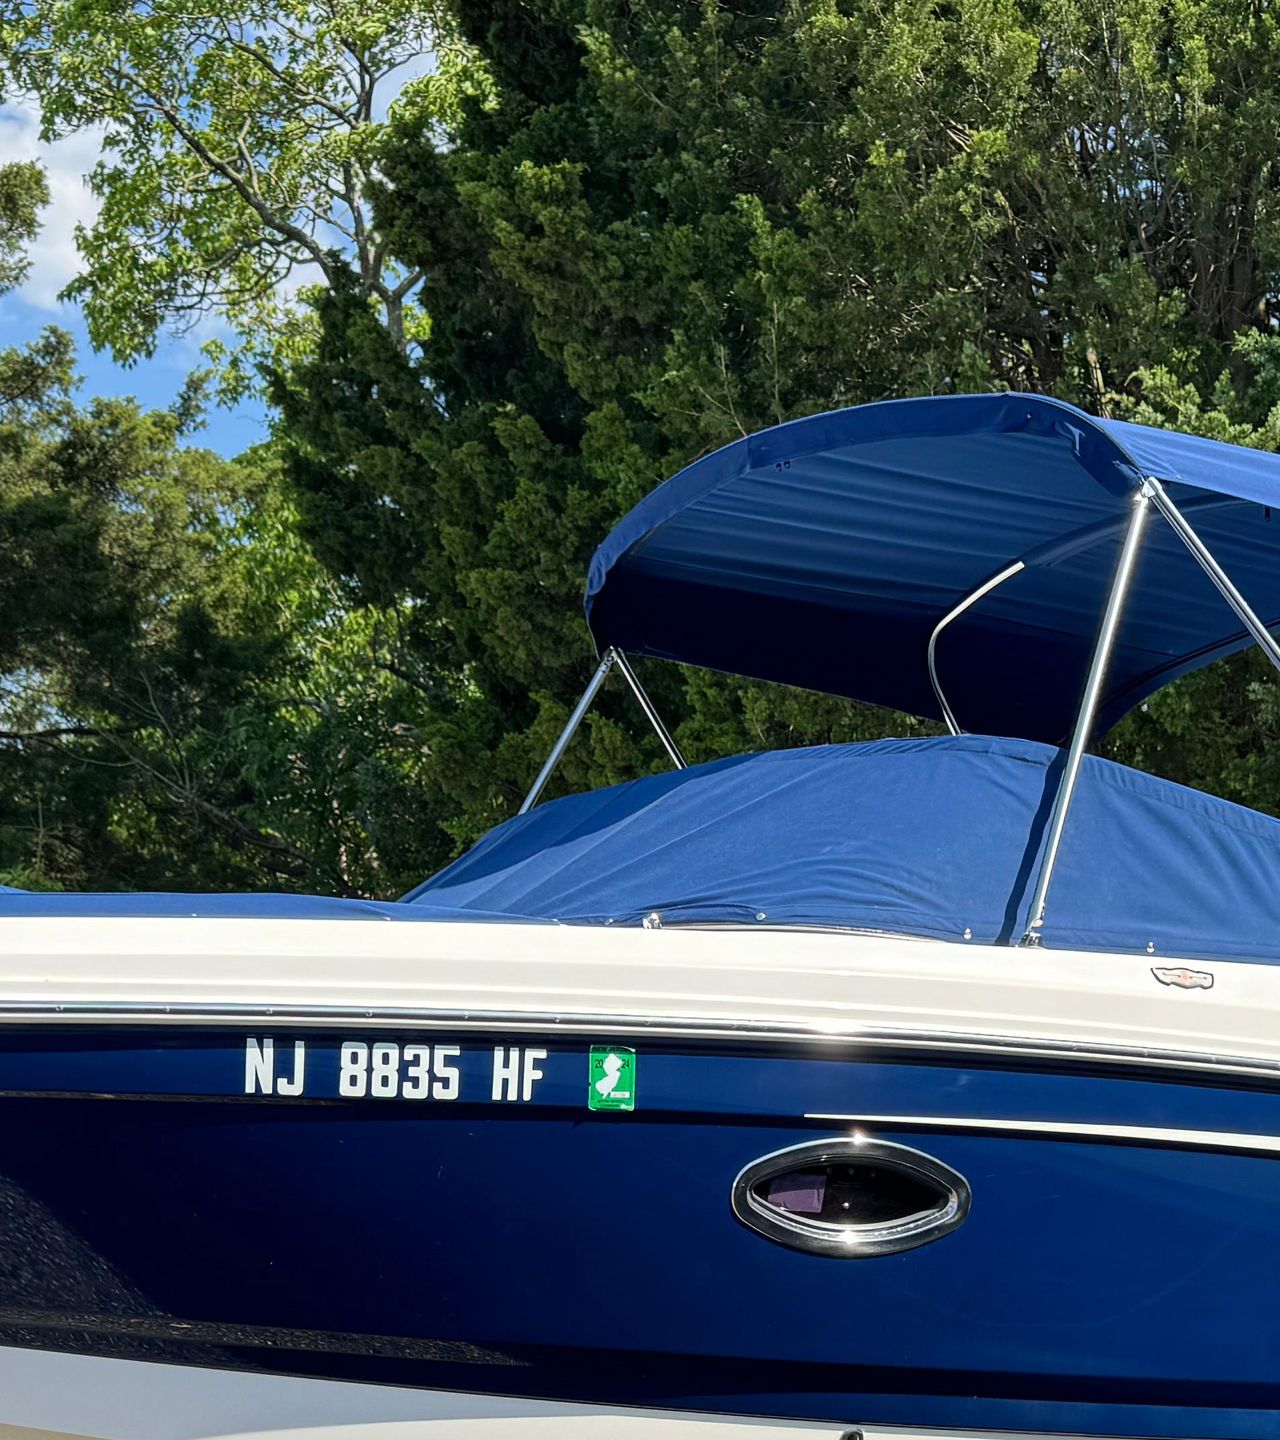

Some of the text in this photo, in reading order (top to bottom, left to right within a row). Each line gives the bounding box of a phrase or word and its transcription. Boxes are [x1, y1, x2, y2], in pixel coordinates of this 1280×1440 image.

[244, 1037, 548, 1102] NJ 8835 HF
